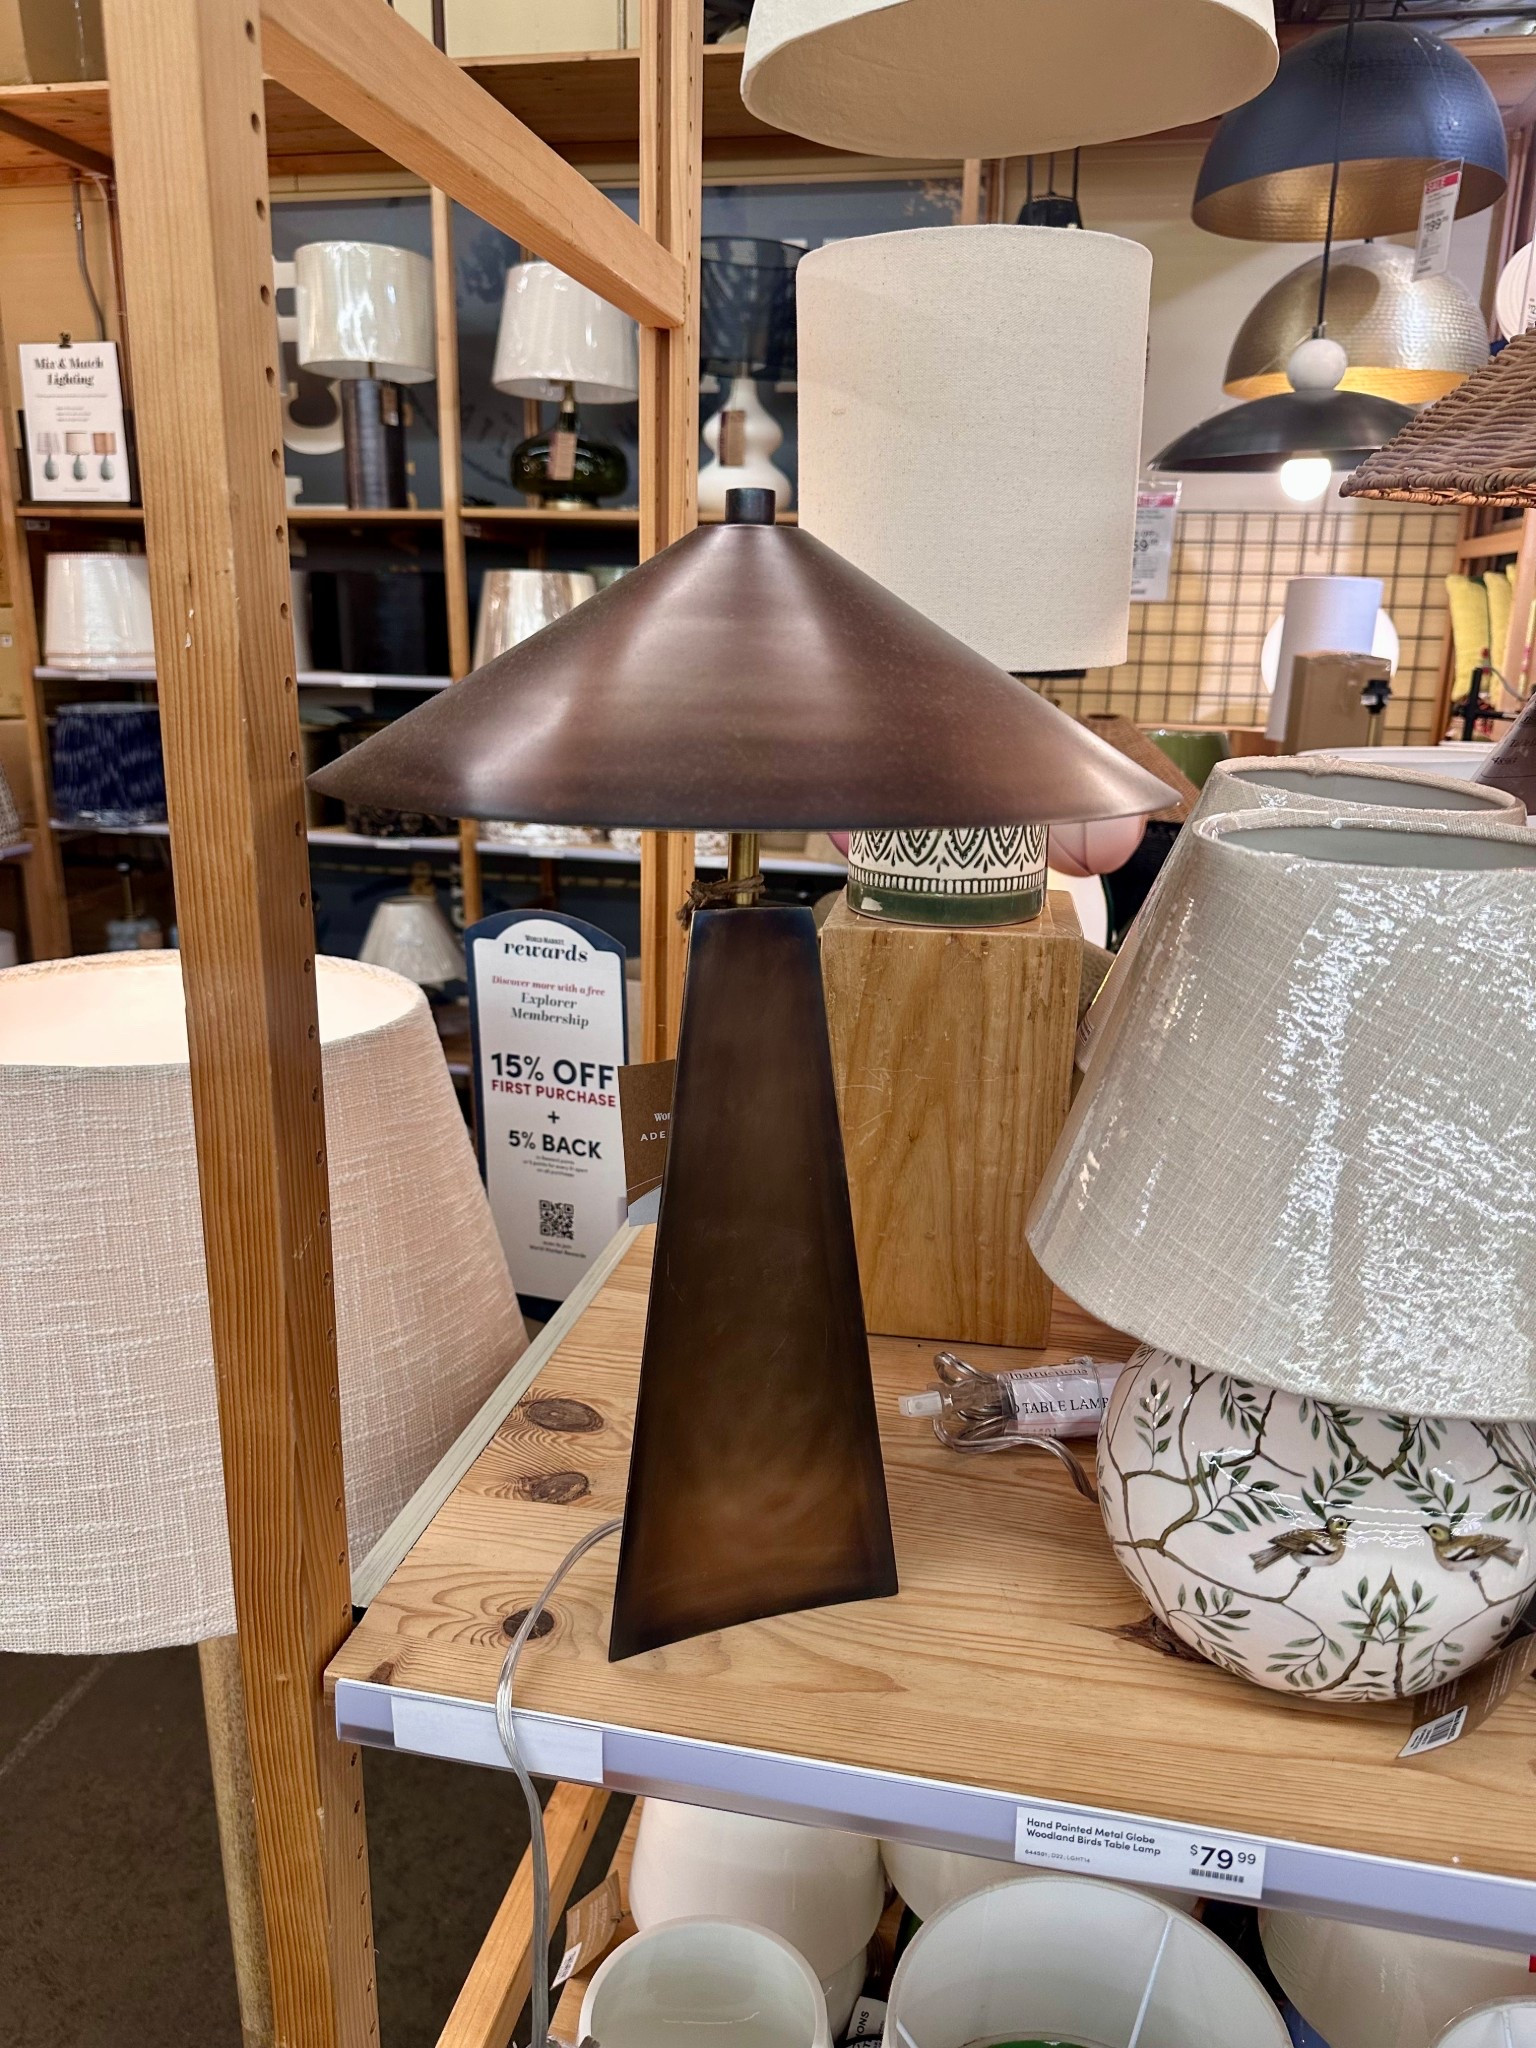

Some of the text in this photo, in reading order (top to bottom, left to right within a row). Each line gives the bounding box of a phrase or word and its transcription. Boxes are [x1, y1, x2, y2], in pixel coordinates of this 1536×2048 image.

[57, 358, 67, 370] &
[70, 357, 104, 370] Match
[47, 373, 94, 387] Lighting
[504, 942, 589, 963] rewards
[492, 975, 530, 988] Discover
[532, 981, 555, 989] more
[557, 983, 578, 993] with
[585, 986, 606, 996] free
[521, 992, 577, 1008] Explorer
[511, 1007, 589, 1029] Membership
[491, 1053, 614, 1089] 15% OFF
[492, 1079, 616, 1107] FIRST PURCHASE
[509, 1130, 603, 1159] 5% BACK
[1022, 1401, 1067, 1414] TABLE
[1071, 1397, 1109, 1411] LAMP
[1026, 1817, 1155, 1844] Hand Painted Metal Globe
[1026, 1828, 1161, 1857] Woodland Birds Table Lamp
